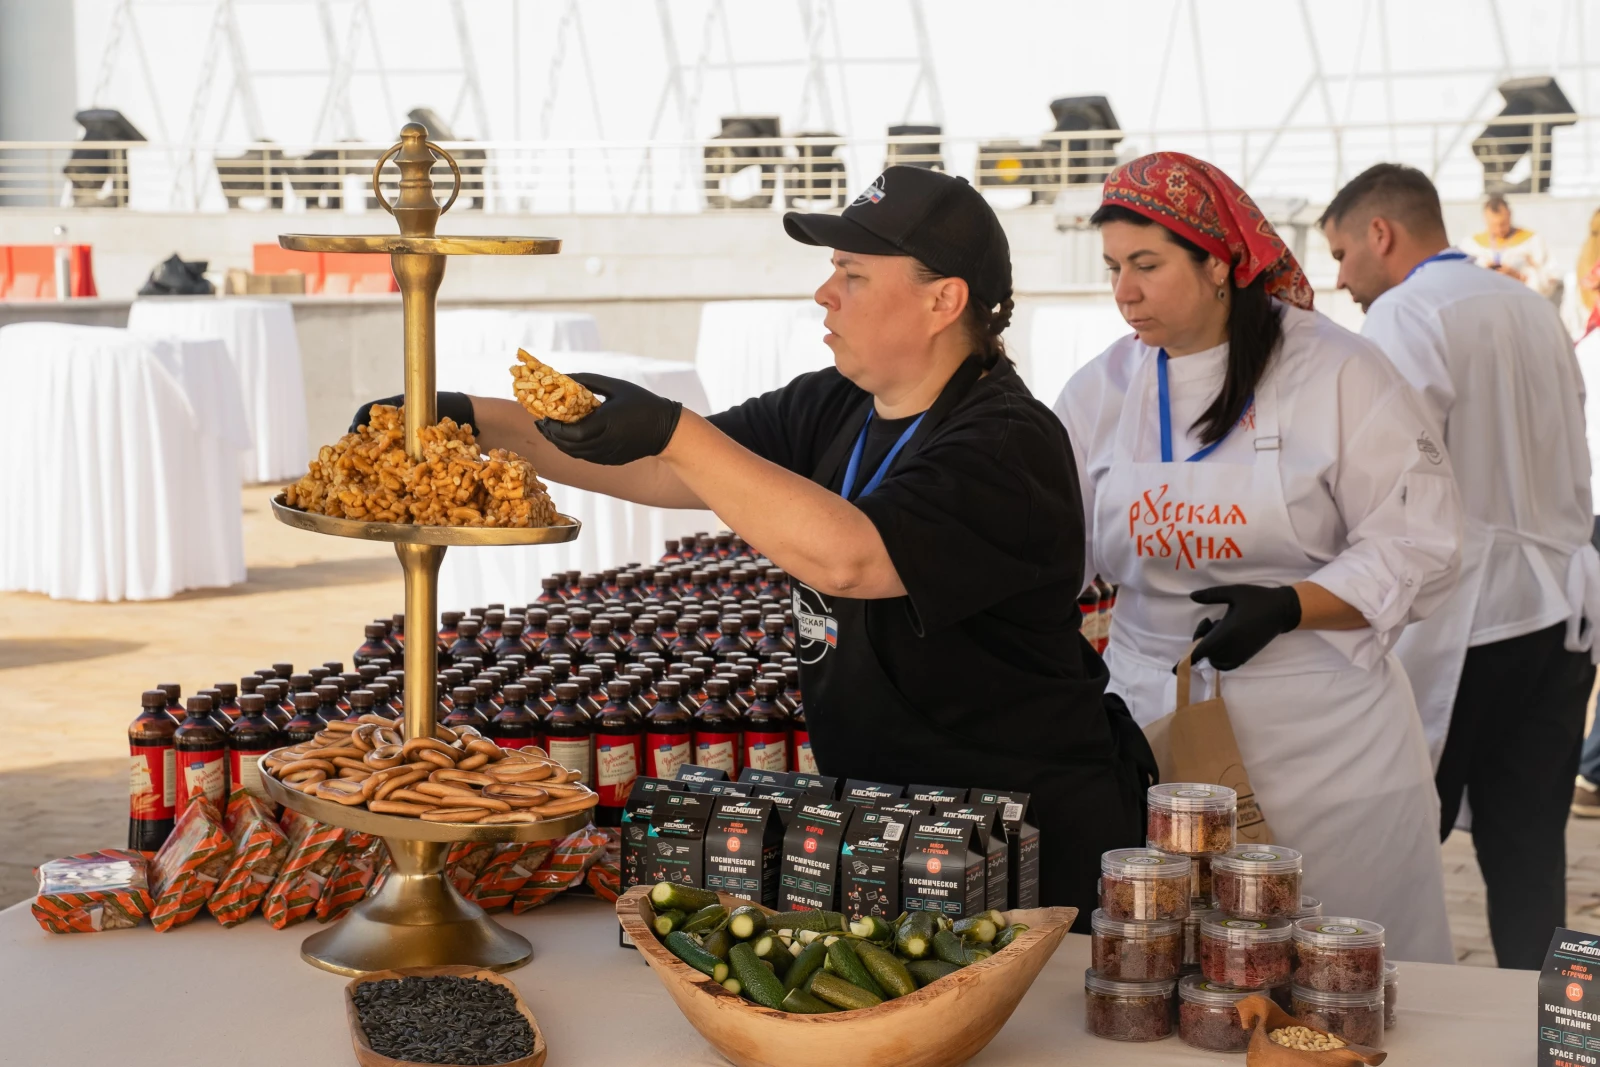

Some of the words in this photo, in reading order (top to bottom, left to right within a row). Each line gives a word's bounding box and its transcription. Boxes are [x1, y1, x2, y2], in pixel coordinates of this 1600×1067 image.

[721, 805, 761, 815] КОСМОПИТ
[802, 805, 842, 819] КОСМОПИТ
[805, 825, 824, 835] БОРЩ
[919, 824, 962, 836] КОСМОПИТ
[710, 855, 756, 867] КОСМИЧЕСКОЕ
[786, 854, 831, 870] КОСМИЧЕСКОЕ
[718, 865, 748, 874] ПИТАНИЕ
[793, 864, 822, 877] ПИТАНИЕ
[909, 877, 958, 889] КОСМИЧЕСКОЕ
[918, 887, 949, 897] ПИТАНИЕ
[786, 893, 806, 904] SPACE
[806, 898, 823, 908] FOOD
[1567, 970, 1593, 981] ГРЕЧКОЙ
[1555, 1016, 1592, 1031] ПИТАНИЕ
[1549, 1047, 1574, 1060] SPACE
[1576, 1053, 1597, 1065] FOOD
